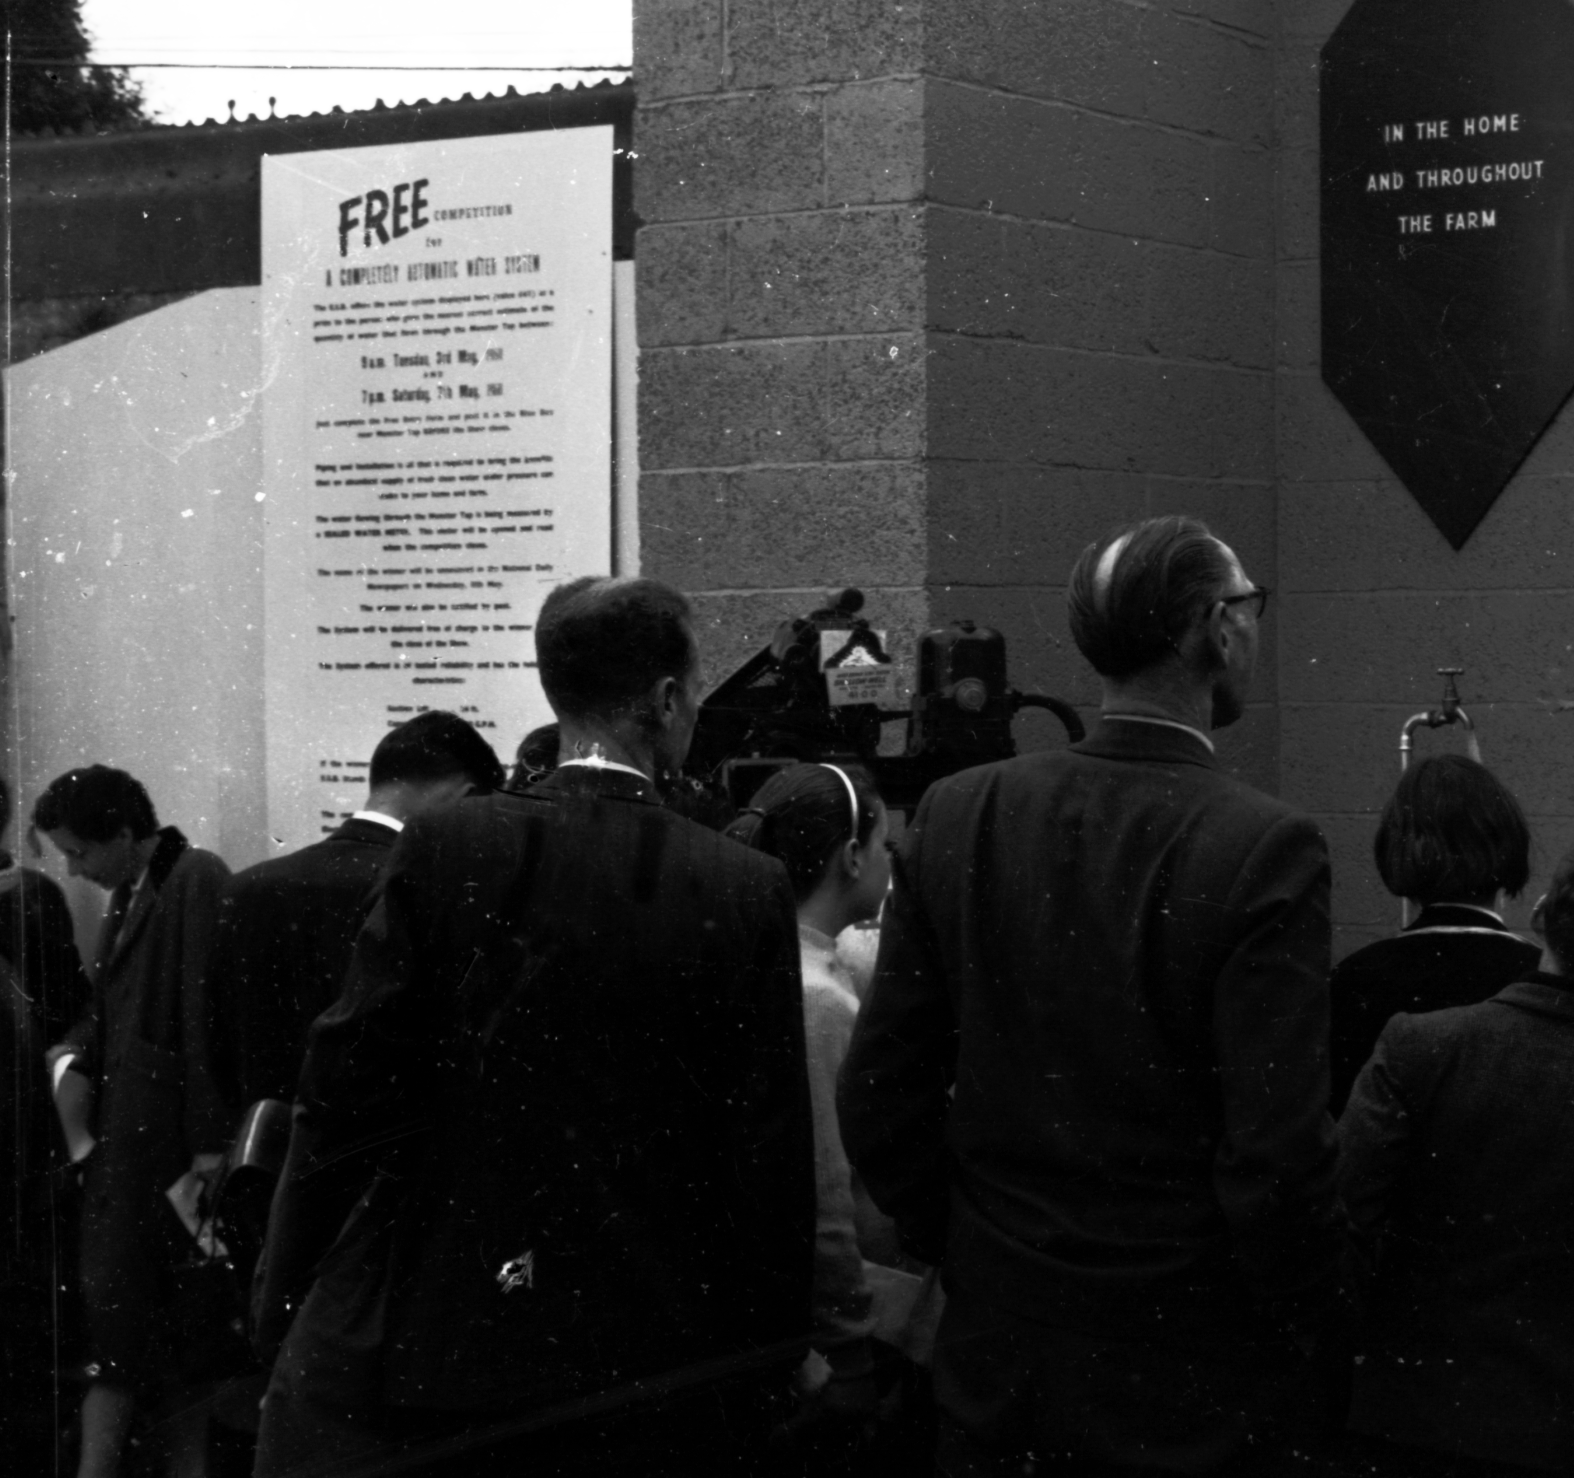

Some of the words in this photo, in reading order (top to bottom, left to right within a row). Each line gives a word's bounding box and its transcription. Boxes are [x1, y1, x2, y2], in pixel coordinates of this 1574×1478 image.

[1385, 124, 1403, 142] IN
[1417, 121, 1449, 140] THE
[1464, 114, 1519, 136] HOME
[1366, 172, 1404, 192] AND
[1417, 161, 1544, 188] THROUGHOUT
[338, 178, 430, 257] FREE
[433, 205, 513, 221] COMPETITION
[1399, 215, 1432, 233] THE
[1446, 210, 1496, 231] FARM
